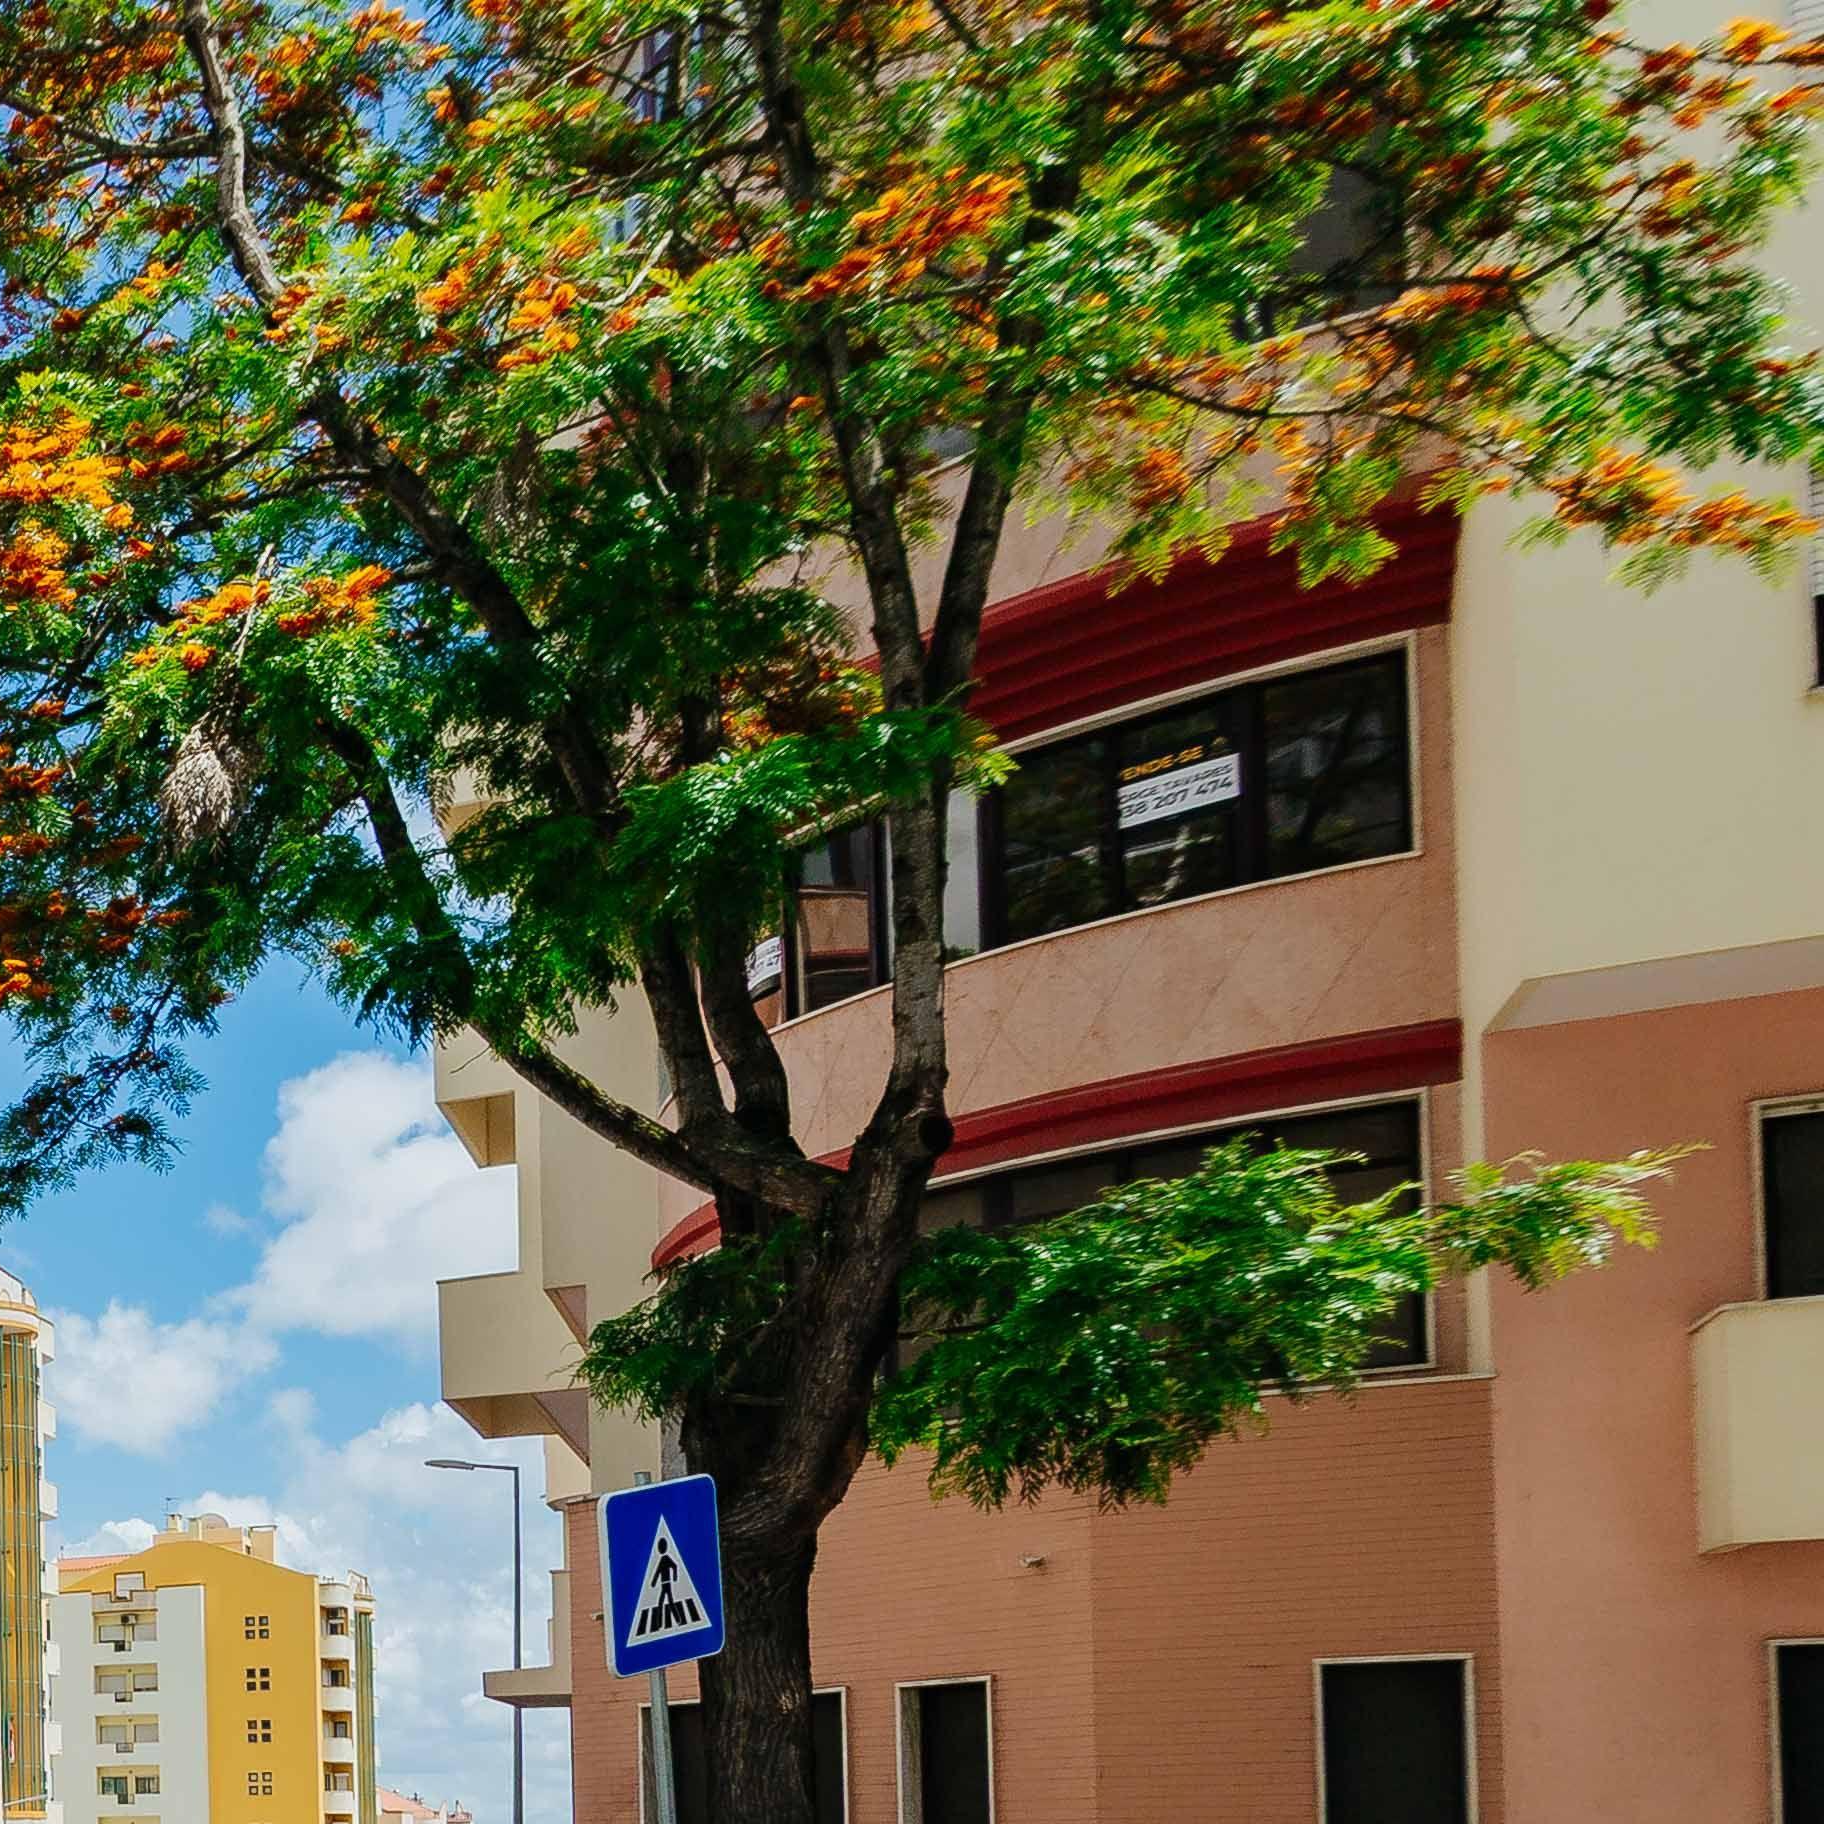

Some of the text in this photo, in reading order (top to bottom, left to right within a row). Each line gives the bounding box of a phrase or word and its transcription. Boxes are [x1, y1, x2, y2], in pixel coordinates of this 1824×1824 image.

[1119, 745, 1203, 781] ENDE-SE
[1119, 785, 1160, 805] ORGE
[1152, 788, 1189, 810] 207
[1194, 775, 1233, 796] 474
